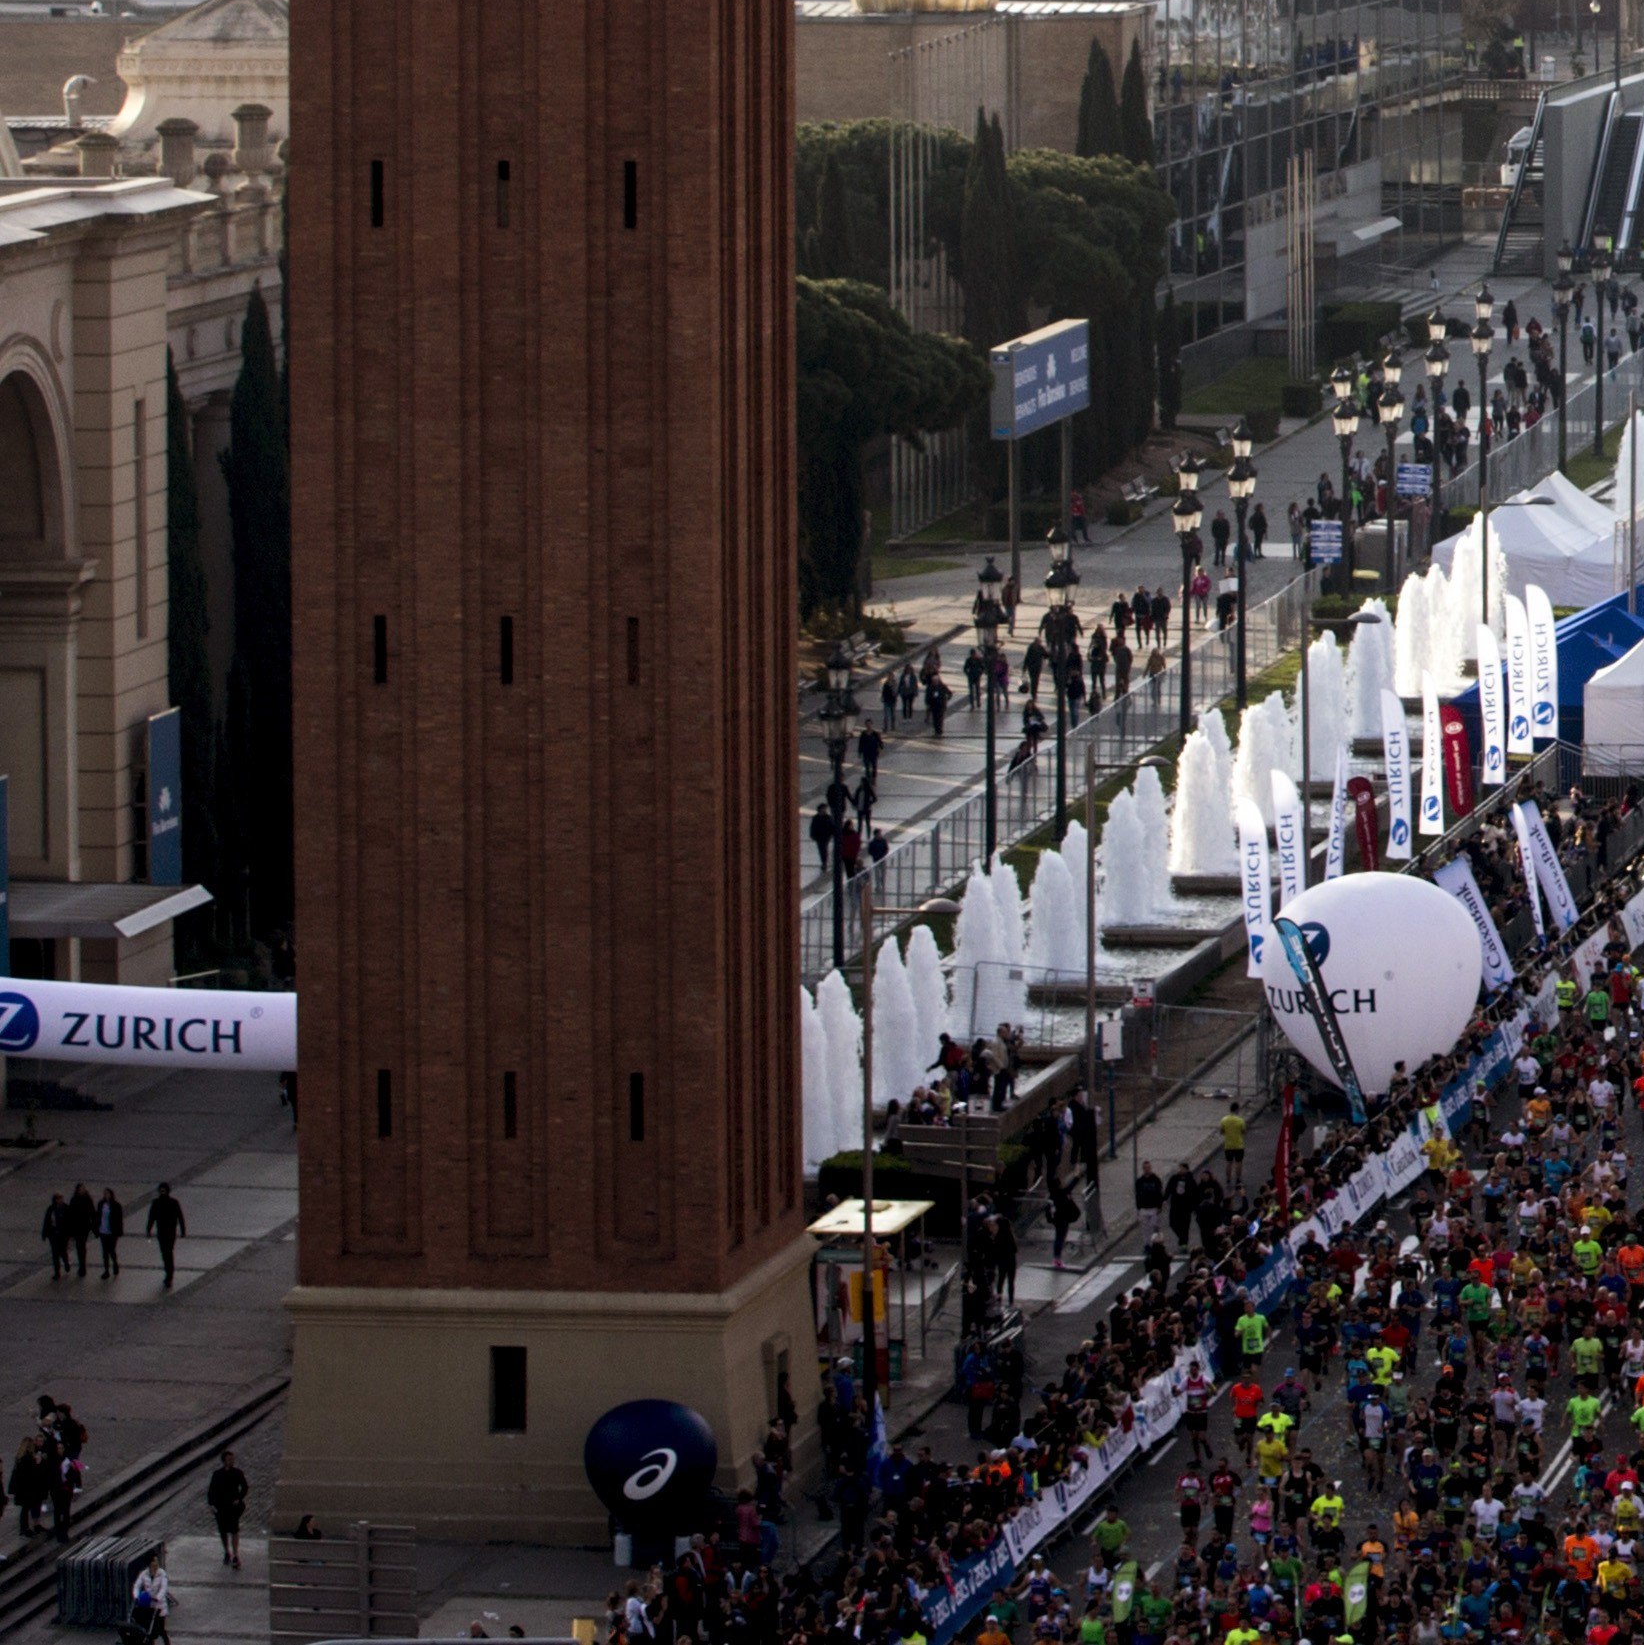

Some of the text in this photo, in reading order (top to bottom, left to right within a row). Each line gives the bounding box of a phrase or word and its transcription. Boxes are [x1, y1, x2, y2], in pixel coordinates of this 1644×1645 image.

[1529, 824, 1568, 908] CaixaBank
[1456, 882, 1502, 970] CaixaBank
[1267, 986, 1377, 1015] ZURCH
[60, 1012, 243, 1054] ZURICH
